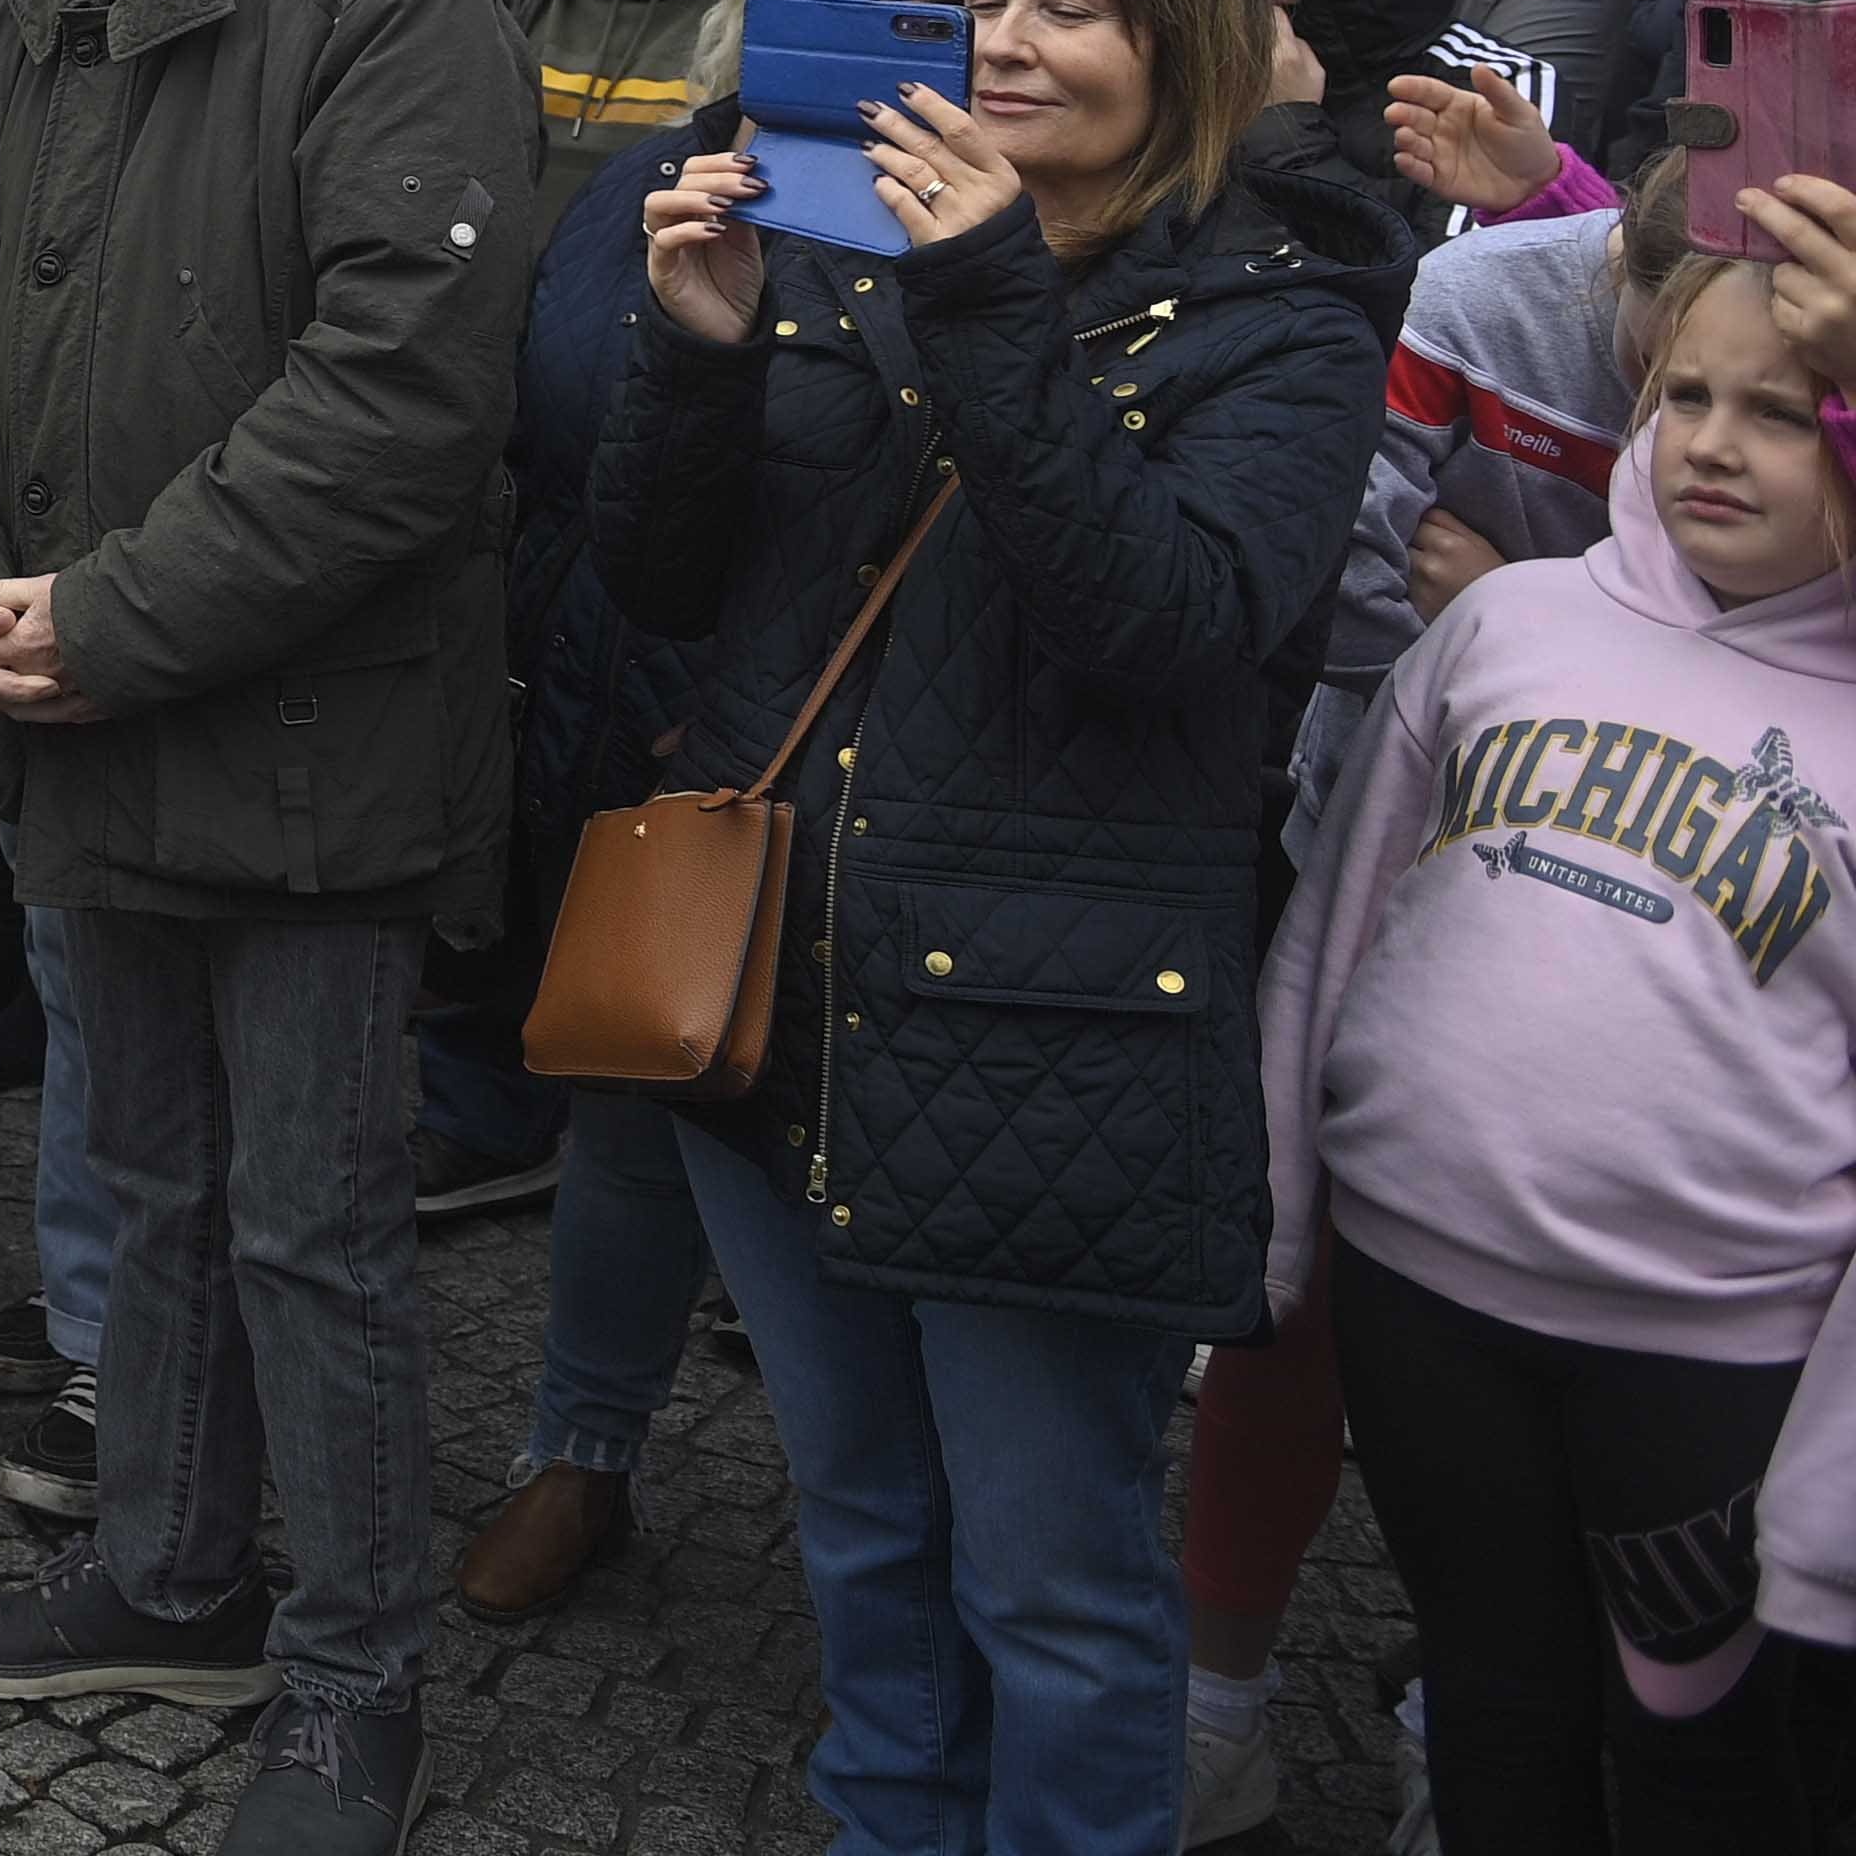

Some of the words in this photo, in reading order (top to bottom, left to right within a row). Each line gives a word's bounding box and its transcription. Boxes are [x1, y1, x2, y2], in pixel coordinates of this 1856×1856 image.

[1417, 718, 1833, 988] MICHIGAN
[1527, 854, 1588, 890] UNITED
[1594, 880, 1658, 914] STATES
[1584, 1480, 1760, 1642] NIK
